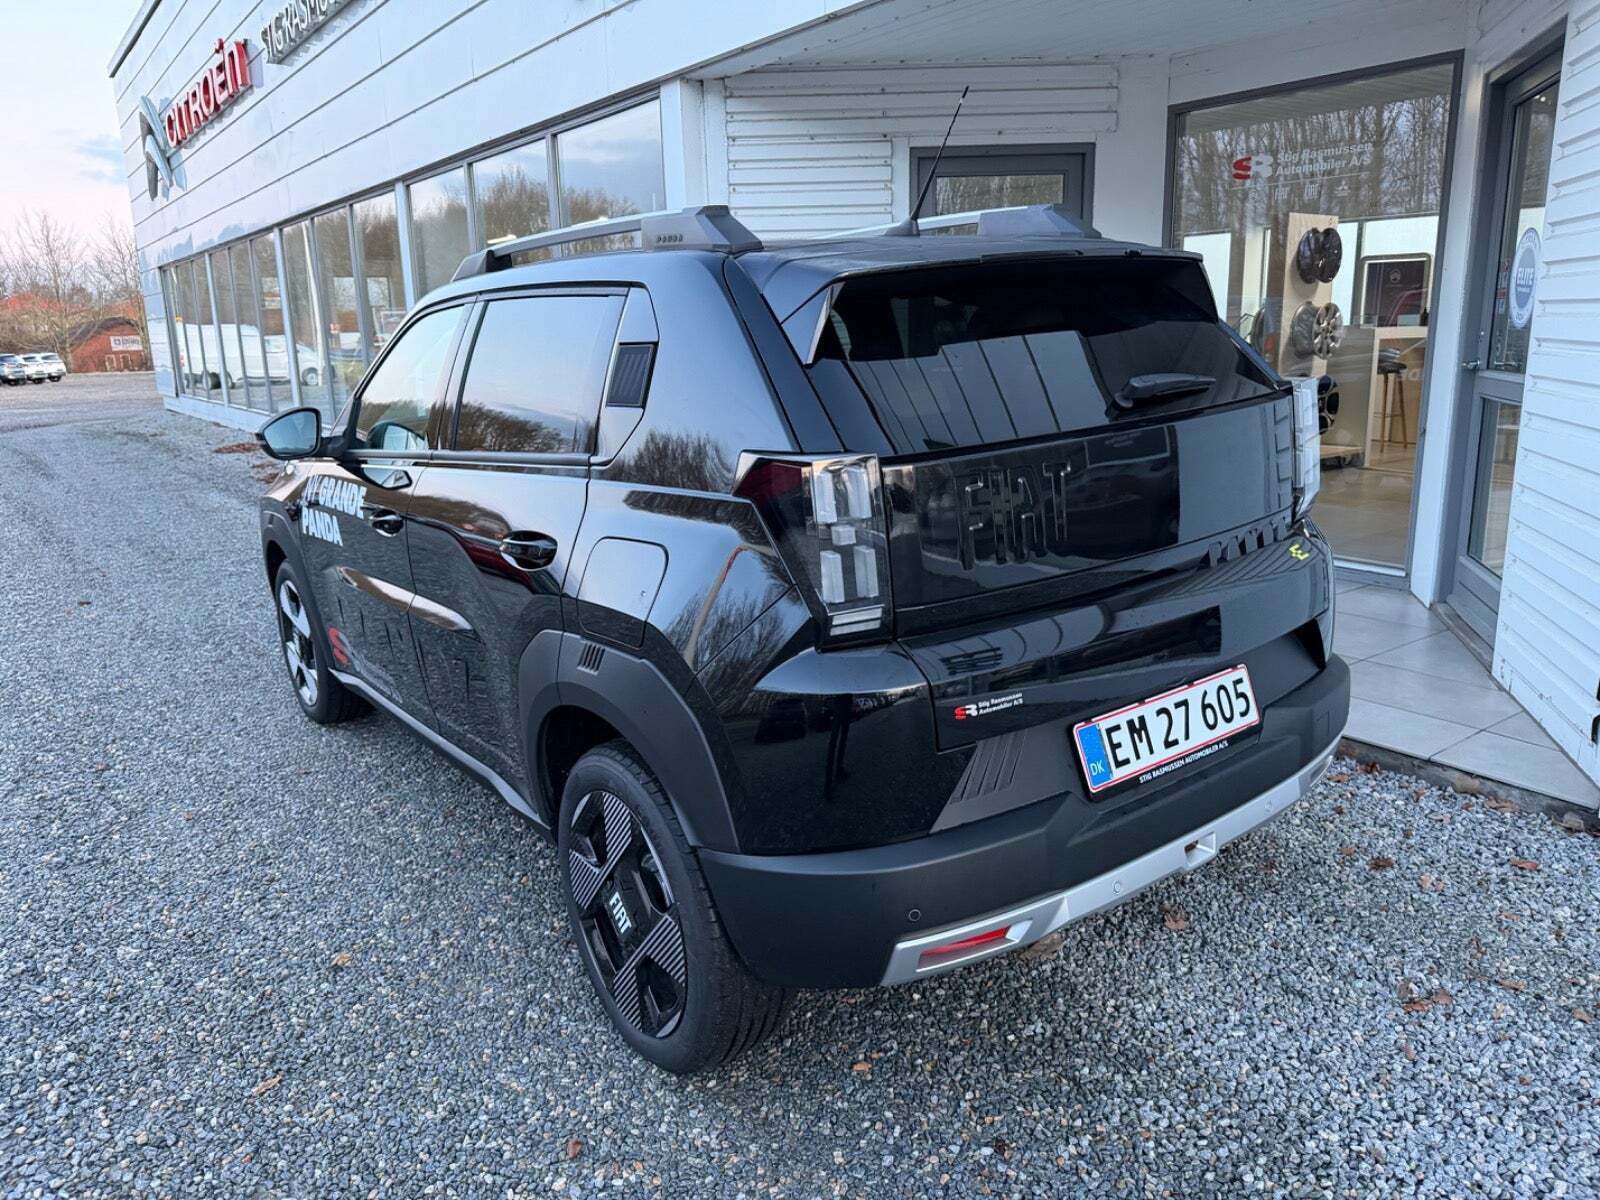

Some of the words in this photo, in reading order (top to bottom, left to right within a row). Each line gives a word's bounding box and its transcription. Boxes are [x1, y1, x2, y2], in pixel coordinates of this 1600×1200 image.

[1276, 159, 1347, 176] Automobiler
[1349, 154, 1372, 167] A/S
[319, 476, 367, 520] GRANDE
[954, 461, 1072, 569] FIAT
[302, 505, 343, 547] PANDA
[1105, 714, 1154, 769] EM
[1156, 698, 1190, 750] 27
[1201, 677, 1250, 731] 605
[1090, 760, 1105, 777] DK
[1139, 772, 1153, 783] STIG
[1153, 759, 1185, 777] RASMUSSEN
[1185, 744, 1218, 763] AUTOMOBILER
[609, 891, 632, 934] FIAT
